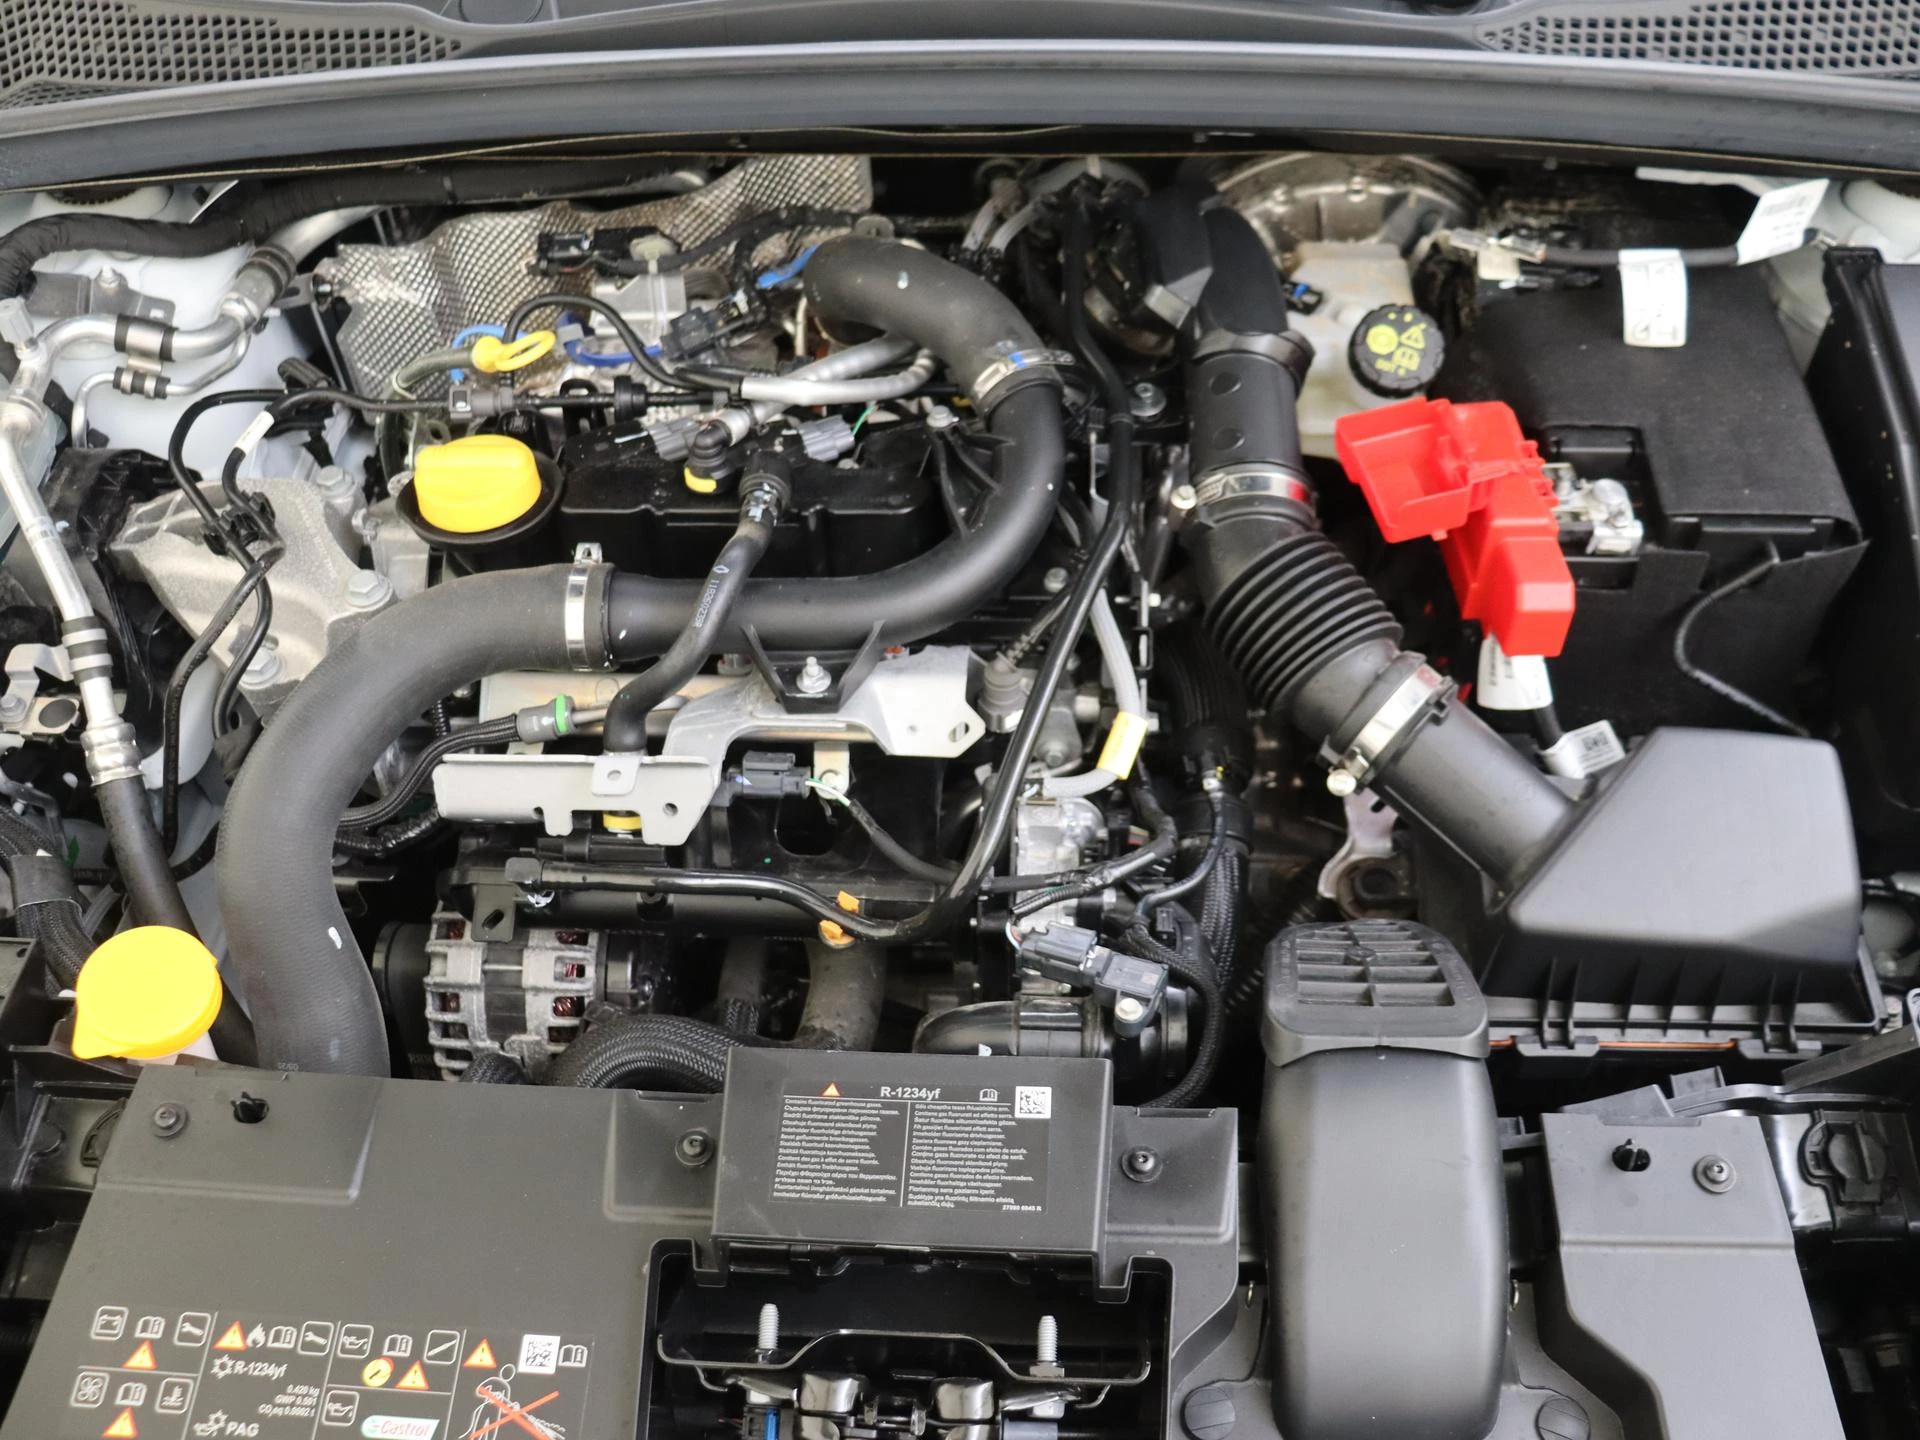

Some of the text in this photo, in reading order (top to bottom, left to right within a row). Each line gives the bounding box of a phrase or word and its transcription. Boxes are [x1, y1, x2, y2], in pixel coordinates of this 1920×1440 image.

[880, 1086, 942, 1100] R-1234yf
[234, 1360, 288, 1380] R-1234yf
[309, 1386, 320, 1396] kg
[274, 1395, 295, 1404] GWP
[225, 1421, 260, 1437] PAG
[381, 1420, 431, 1437] Castrol
